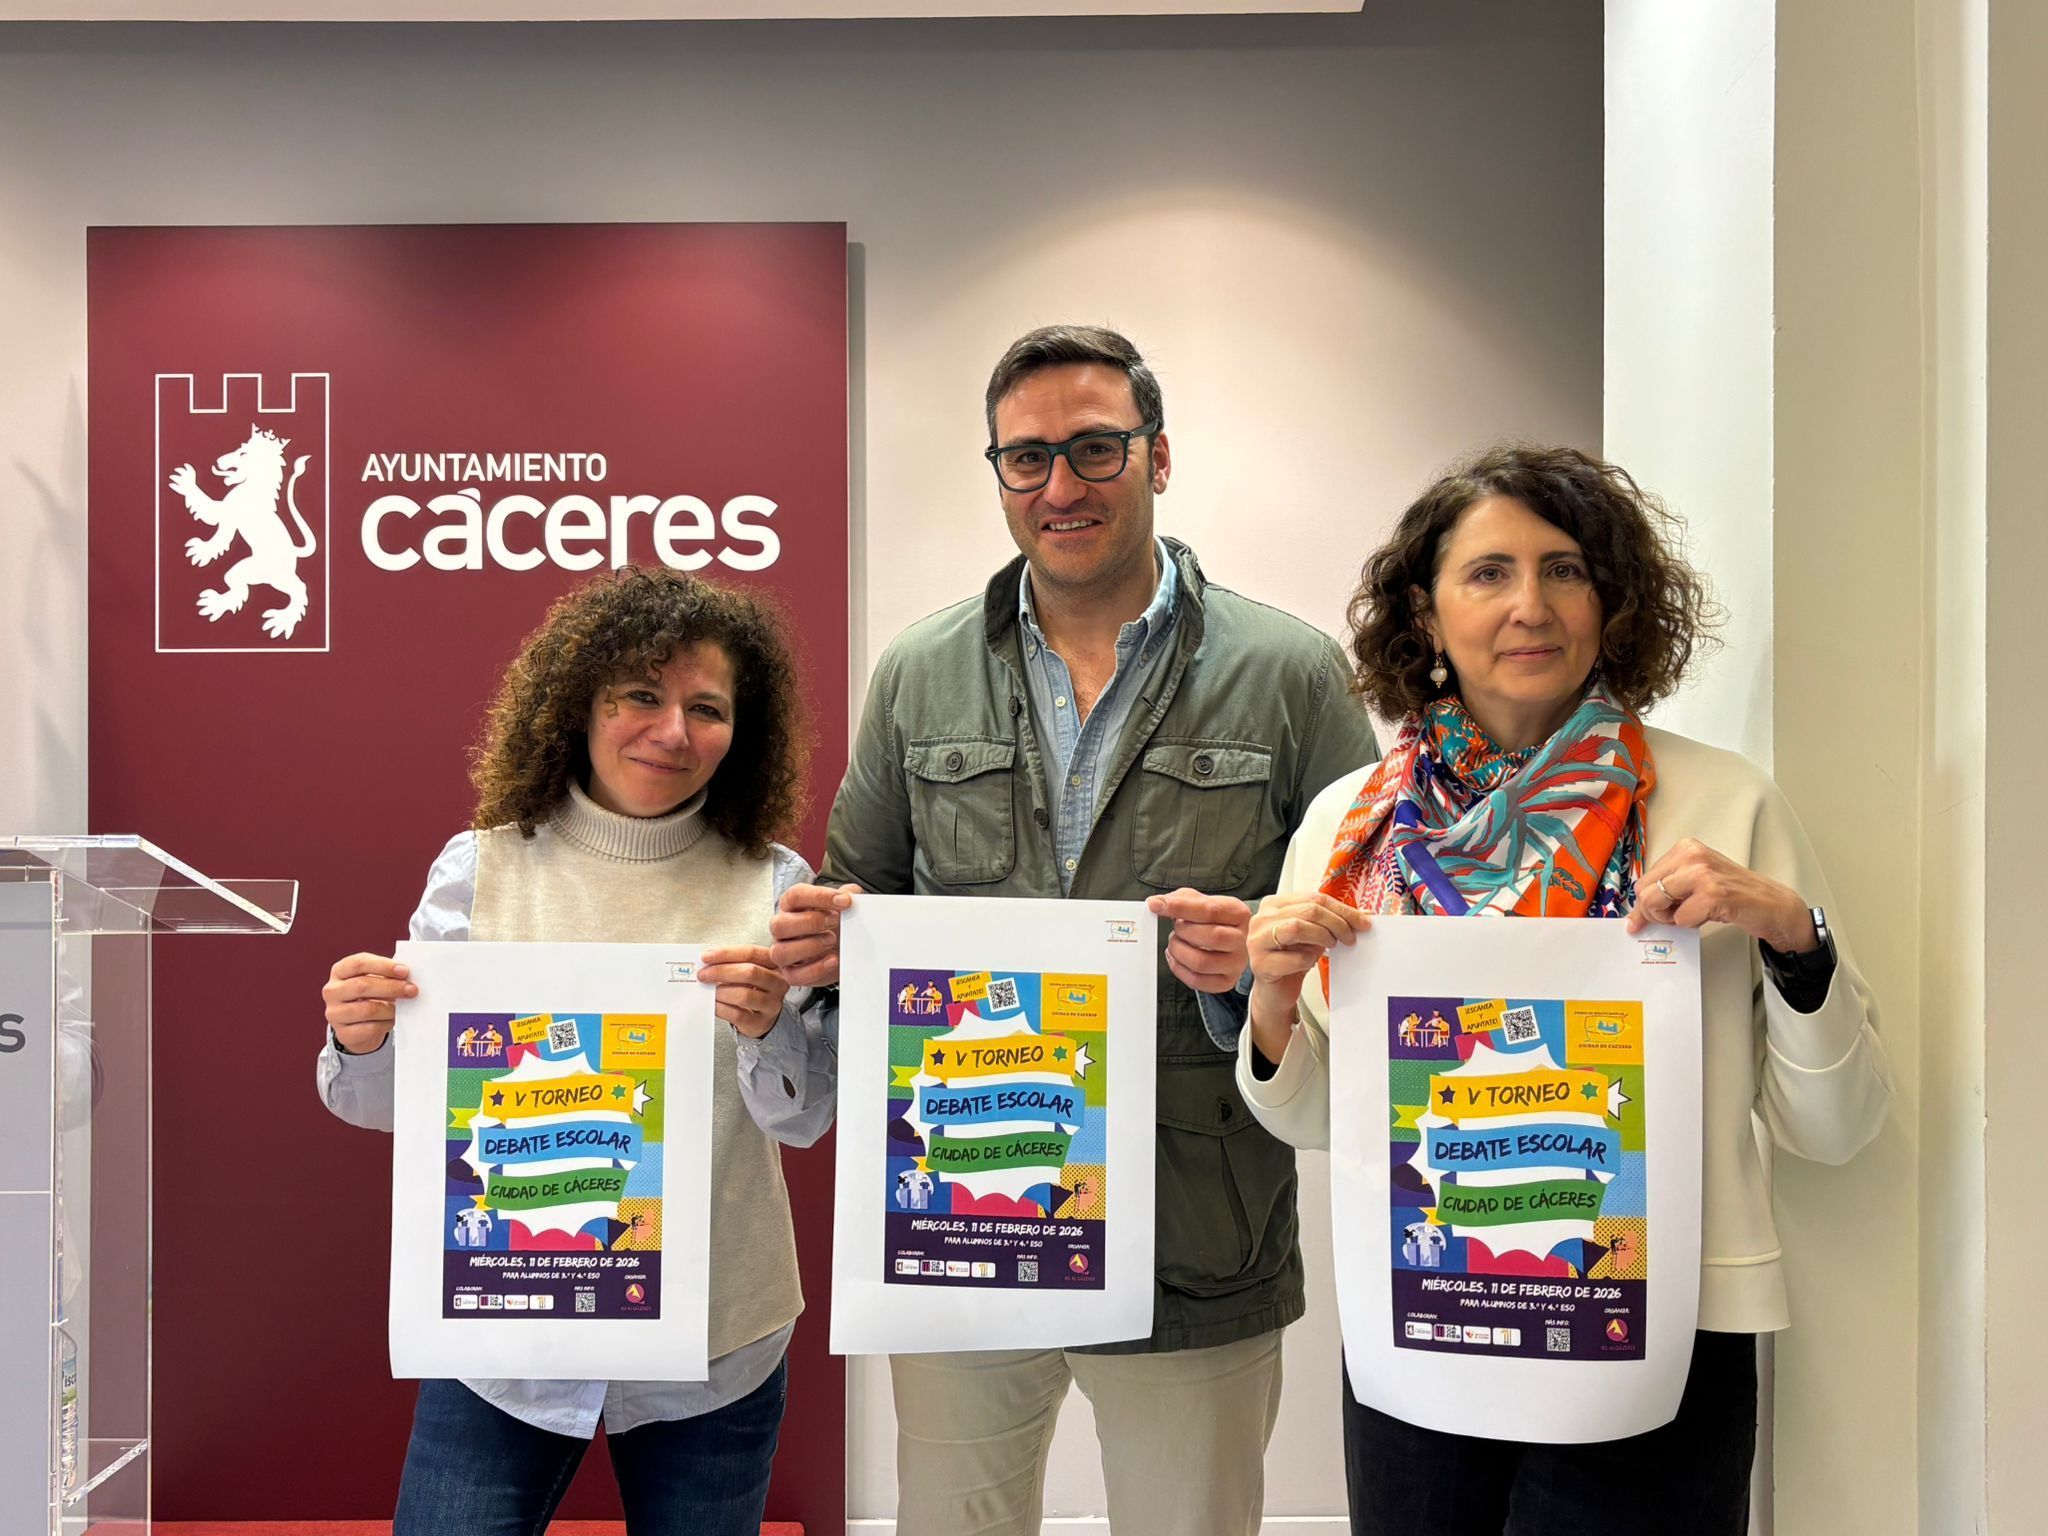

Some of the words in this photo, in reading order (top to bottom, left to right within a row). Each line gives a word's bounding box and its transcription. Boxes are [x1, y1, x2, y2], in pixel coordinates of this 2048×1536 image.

[361, 453, 607, 482] AYUNTAMIENTO
[360, 487, 781, 571] cáceres
[956, 1050, 967, 1067] V
[972, 1045, 1043, 1068] TORNEO
[515, 1092, 527, 1107] V
[531, 1085, 603, 1106] TORNEO
[926, 1095, 992, 1116] DEBATE
[998, 1091, 1073, 1118] ESCOLAR
[1468, 1088, 1481, 1105] V
[1486, 1082, 1570, 1107] TORNEO
[485, 1134, 550, 1155] DEBATE
[556, 1129, 631, 1154] ESCOLAR
[932, 1147, 980, 1163] CIUDAD
[984, 1147, 1001, 1159] DE
[1006, 1140, 1063, 1157] CÁCERES
[1435, 1138, 1511, 1161] DEBATE
[1518, 1134, 1607, 1164] ESCOLAR
[491, 1184, 537, 1199] CIUDAD
[543, 1183, 559, 1196] DE
[564, 1176, 621, 1193] CÁCERES
[1443, 1197, 1499, 1214] CIUDAD
[1504, 1197, 1523, 1211] DE
[1529, 1189, 1597, 1208] CÁCERES
[911, 1217, 968, 1232] MIÉRCOLES,
[979, 1224, 992, 1233] DE
[995, 1224, 1040, 1236] FEBRERO
[1042, 1226, 1056, 1235] DE
[1059, 1226, 1083, 1236] 2026
[944, 1236, 961, 1245] PARA
[962, 1237, 992, 1246] ALUMNOS
[993, 1238, 1002, 1246] DE
[1030, 1240, 1043, 1248] ESO
[469, 1254, 526, 1267] MIÉRCOLES,
[537, 1257, 551, 1267] DE
[553, 1256, 598, 1268] FEBRERO
[600, 1257, 614, 1267] DE
[616, 1257, 640, 1267] 2026
[1422, 1276, 1487, 1293] MIÉRCOLES,
[1500, 1284, 1516, 1295] DE
[1519, 1284, 1571, 1298] FEBRERO
[1575, 1286, 1590, 1298] DE
[1593, 1287, 1621, 1299] 2026
[1460, 1298, 1479, 1308] PARA
[1481, 1299, 1516, 1310] ALUMNOS
[1517, 1301, 1528, 1310] DE
[1541, 1302, 1546, 1311] Y
[1560, 1304, 1575, 1312] ESO
